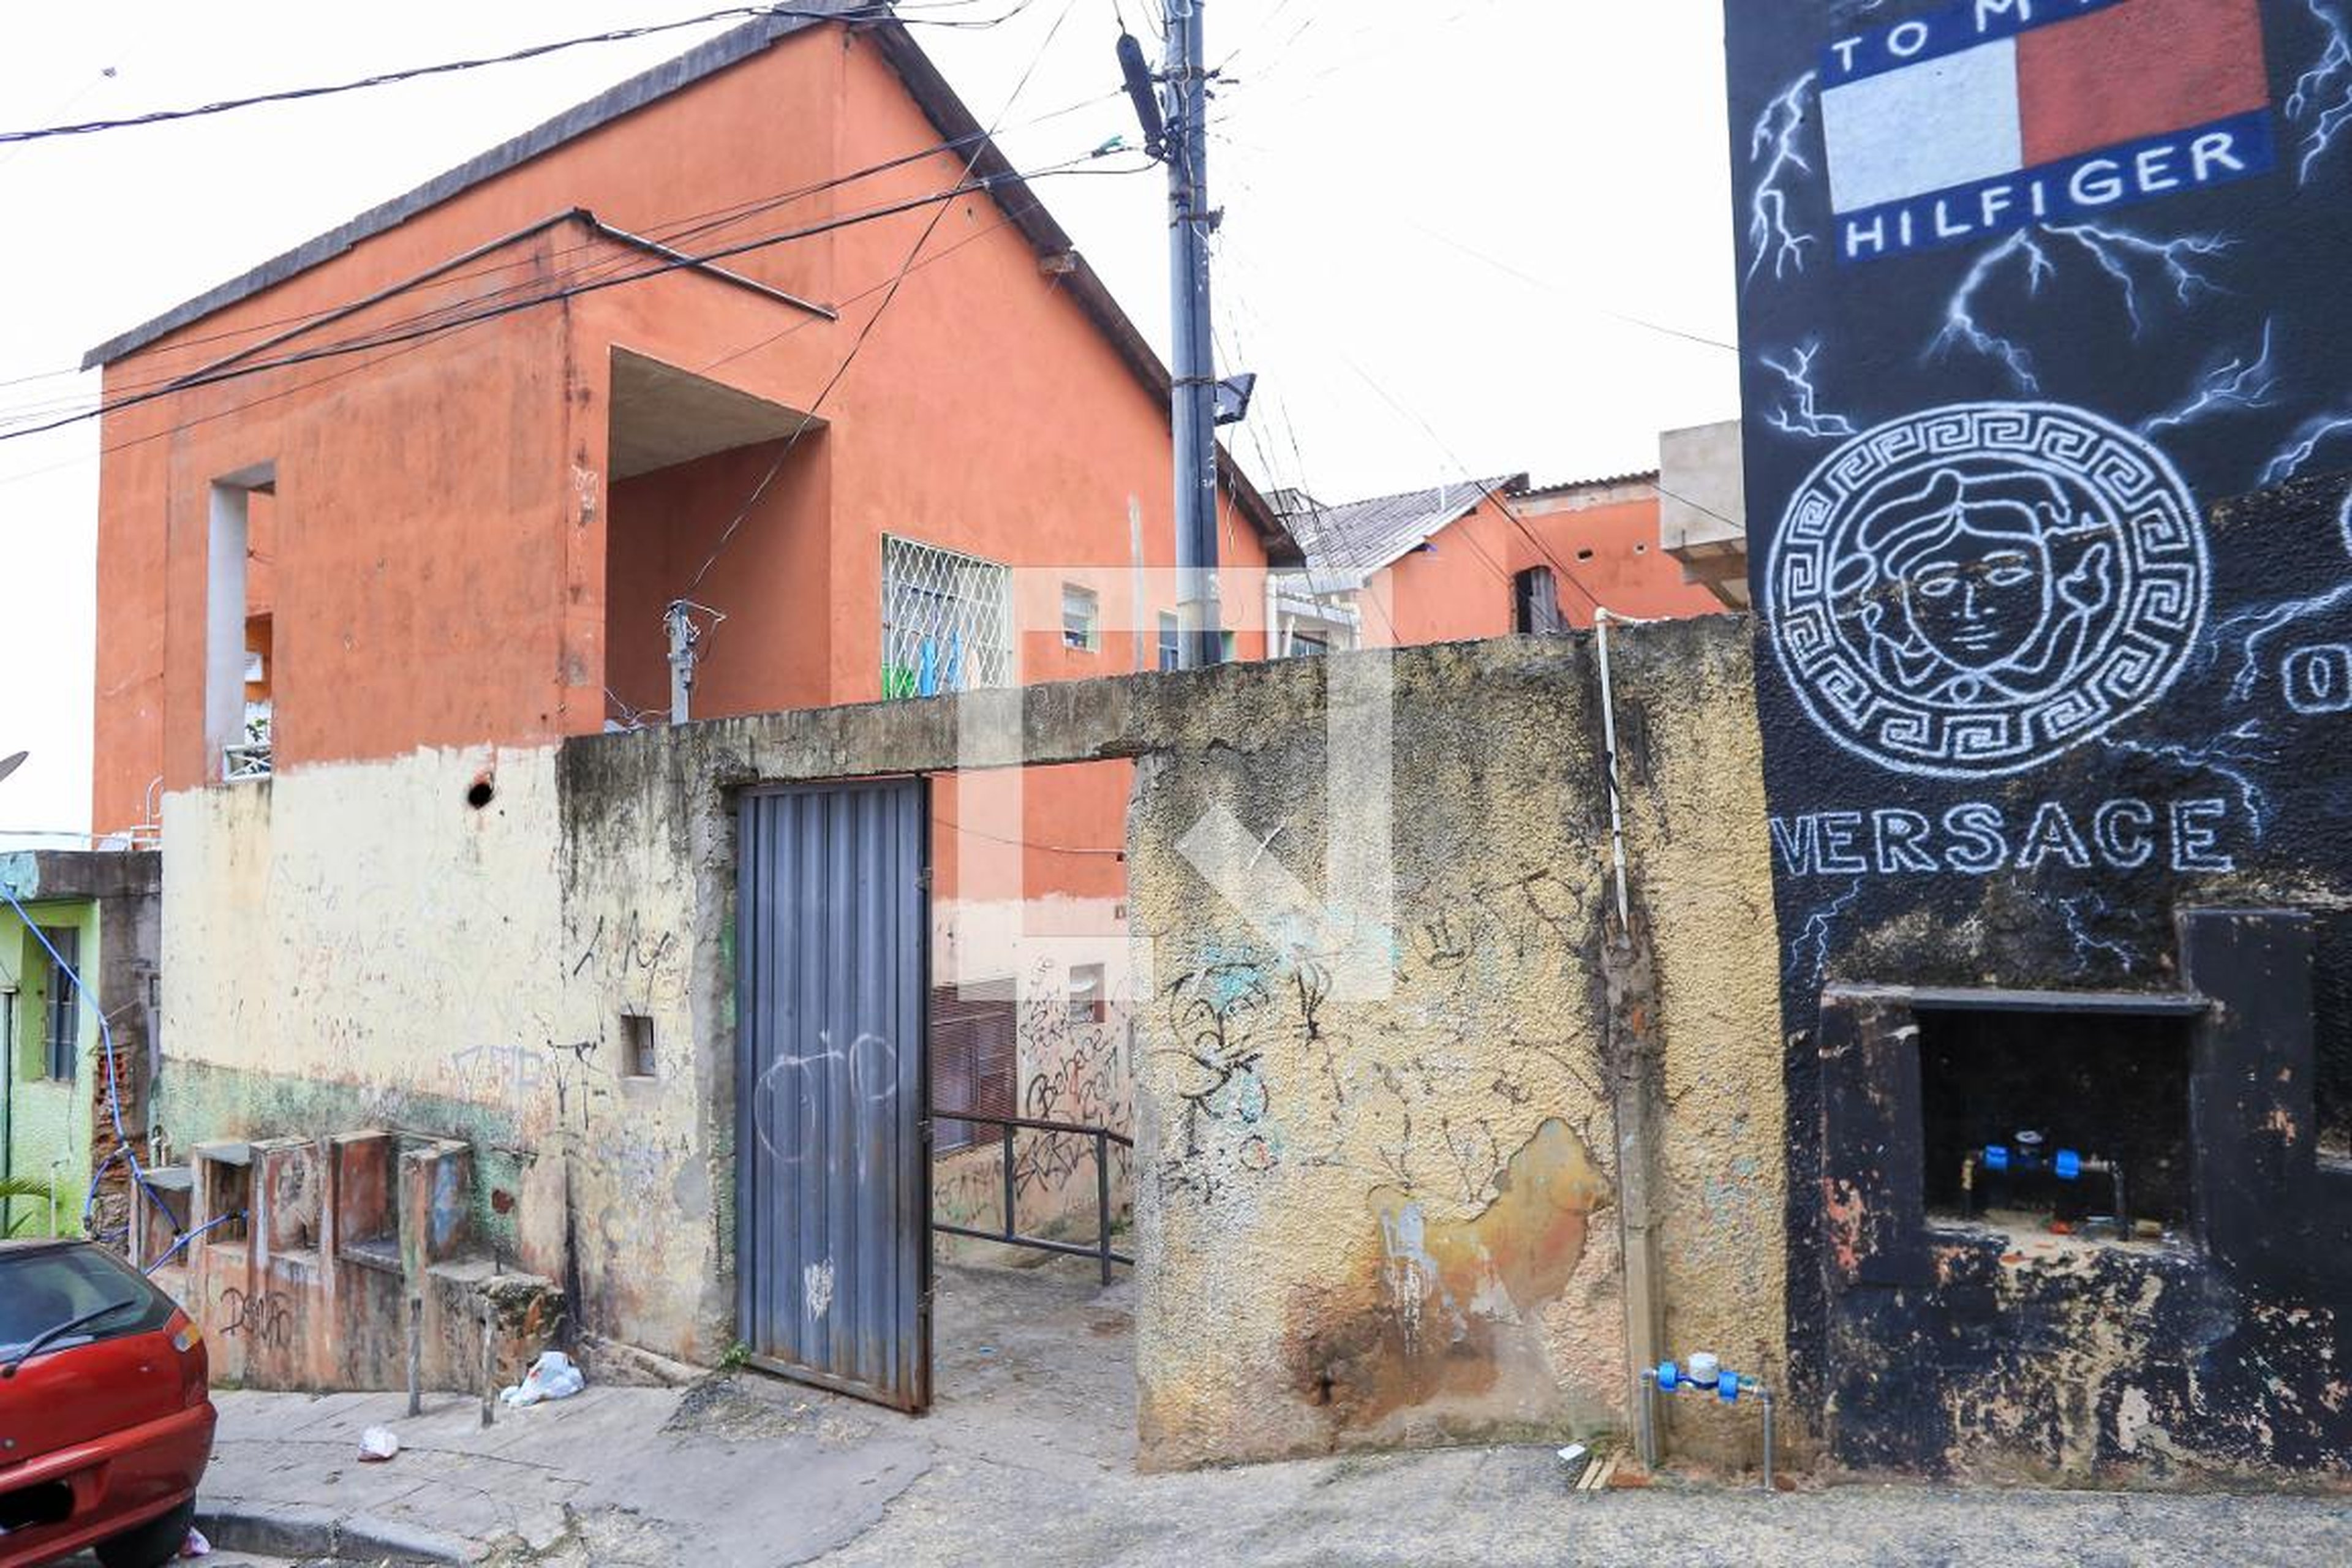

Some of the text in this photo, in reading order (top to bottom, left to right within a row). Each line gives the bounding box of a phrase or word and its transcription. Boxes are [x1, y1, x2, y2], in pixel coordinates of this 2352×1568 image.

[1832, 0, 2084, 72] TOM
[1847, 131, 2245, 257] HILFIGER
[1769, 798, 2235, 876] VERSACE
